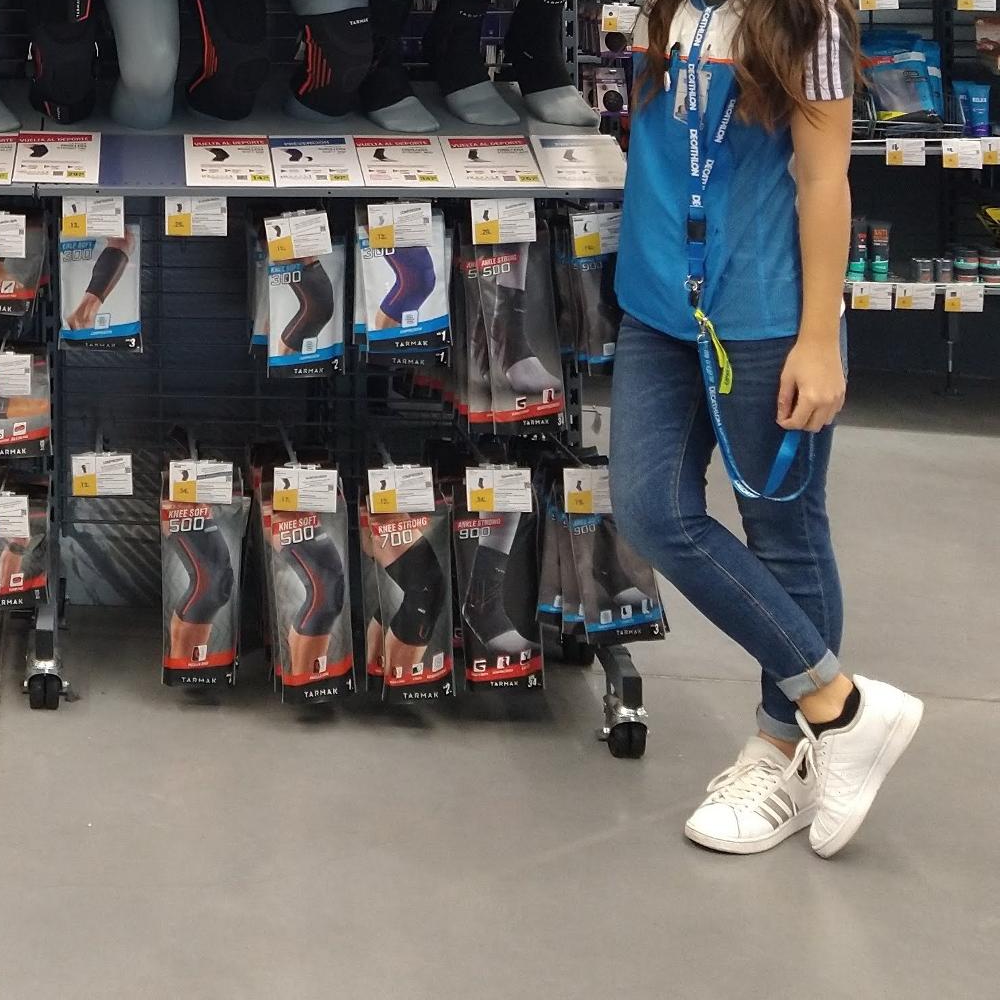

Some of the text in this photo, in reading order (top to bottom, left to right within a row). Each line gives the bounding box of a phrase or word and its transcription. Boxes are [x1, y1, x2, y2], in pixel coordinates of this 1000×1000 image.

[688, 63, 697, 111] DECATHLON
[714, 99, 737, 144] DECATHLON
[690, 128, 699, 177] DECATHLON
[62, 249, 93, 263] 300
[481, 257, 495, 266] ANKLE
[270, 270, 301, 286] 300
[394, 340, 428, 348] TARMAK
[392, 357, 425, 365] TARMAK
[293, 367, 324, 375] TARMAK
[168, 507, 208, 518] KNEE SOFT
[169, 516, 205, 533] 500
[278, 516, 317, 530] KNEE SOFT
[378, 517, 427, 533] KNEE STRONG
[458, 519, 501, 529] ANKLE STRONG
[280, 526, 315, 546] 500
[459, 527, 491, 540] 900
[573, 525, 596, 536] 900
[380, 531, 413, 549] 700
[304, 688, 338, 698] TARMAK
[403, 691, 439, 700] TARMAK
